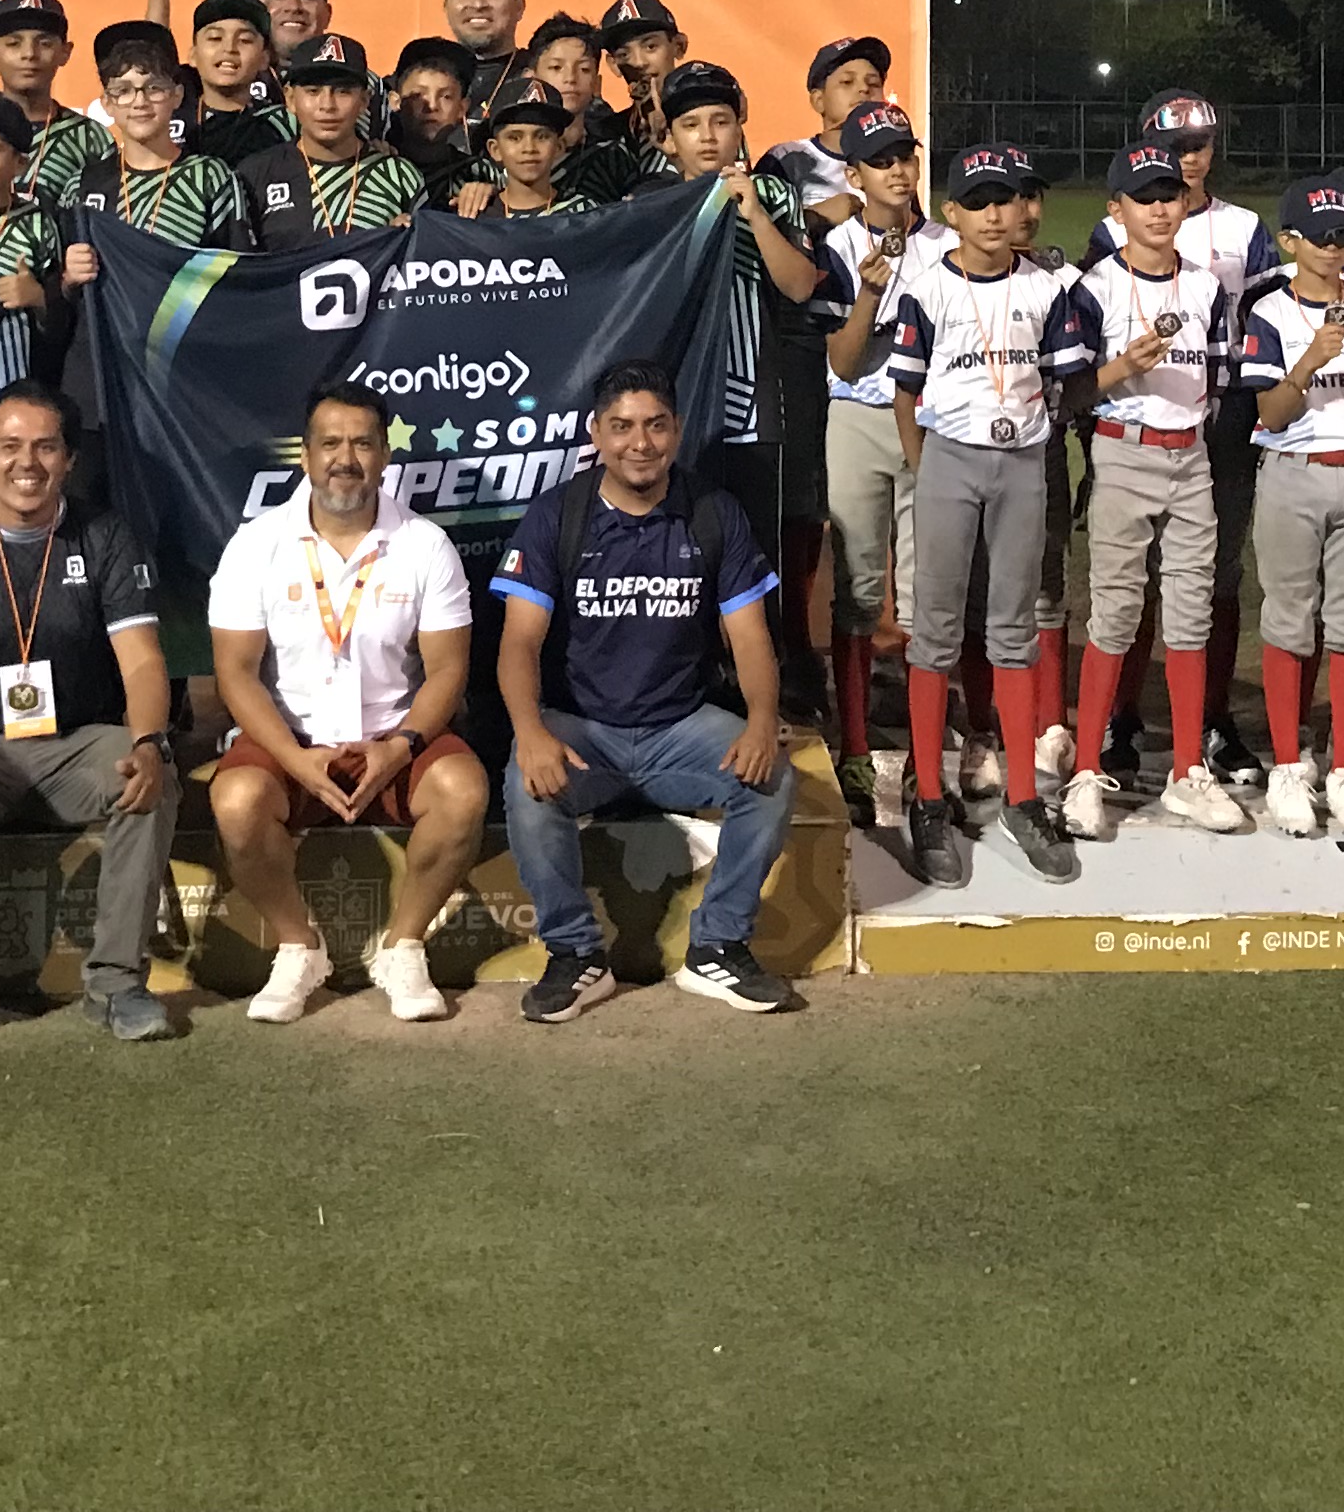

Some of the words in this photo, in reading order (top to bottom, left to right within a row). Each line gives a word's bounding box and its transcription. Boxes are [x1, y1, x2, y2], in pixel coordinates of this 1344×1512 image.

[858, 107, 886, 131] MT
[962, 149, 1005, 171] MTY
[1006, 147, 1028, 164] TY
[1128, 146, 1170, 166] MTY
[380, 257, 566, 293] APODACA
[377, 298, 396, 310] EL
[405, 292, 472, 307] FUTURO
[480, 289, 519, 303] VIVE
[527, 283, 569, 300] AQUÍ
[473, 410, 595, 450] SOM
[575, 577, 598, 597] EL
[605, 576, 703, 597] DEPORTE
[577, 599, 637, 617] SALVA
[645, 599, 700, 617] VIDAS
[182, 898, 229, 917] ÍSICA
[444, 904, 539, 929] UEVO
[1123, 932, 1211, 951] @inde.nl
[1262, 931, 1331, 951] @INDE
